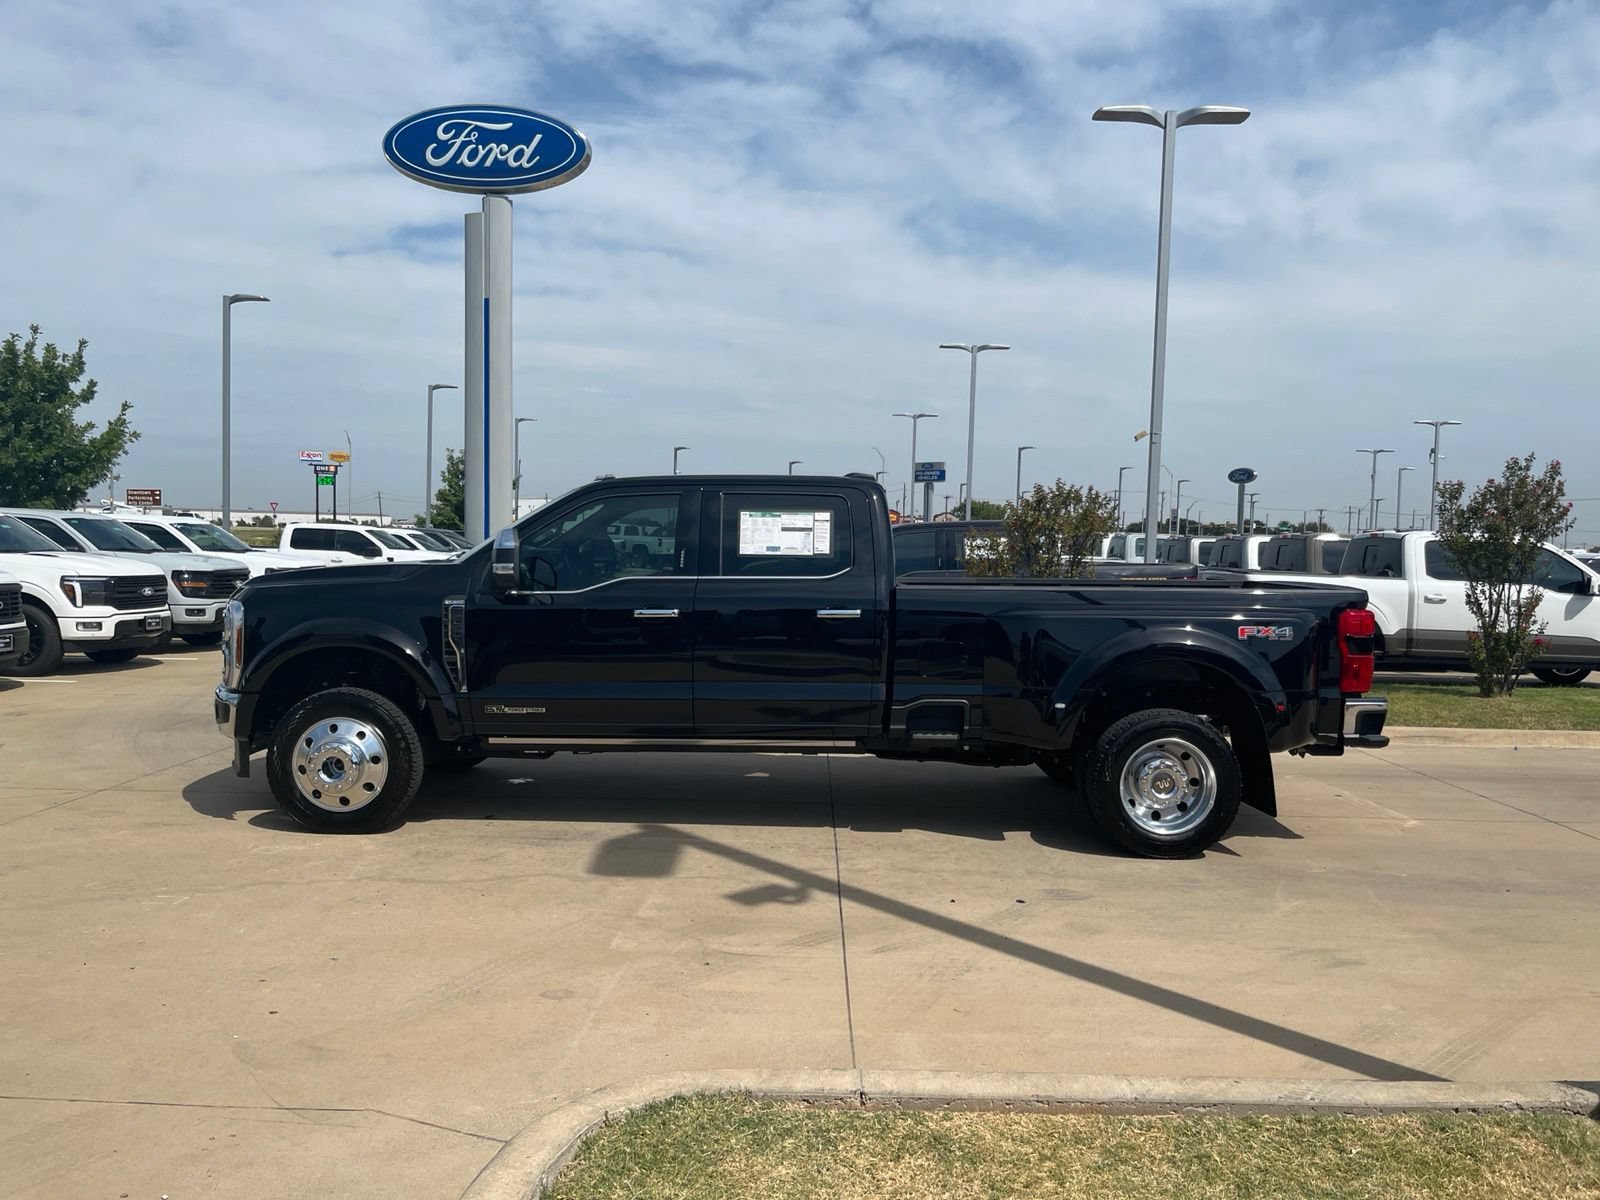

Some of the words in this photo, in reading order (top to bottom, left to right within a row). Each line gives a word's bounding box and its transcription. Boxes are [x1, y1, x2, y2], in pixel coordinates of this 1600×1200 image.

[425, 119, 542, 168] Ford
[301, 451, 321, 459] Exxon
[1238, 626, 1293, 640] FX4
